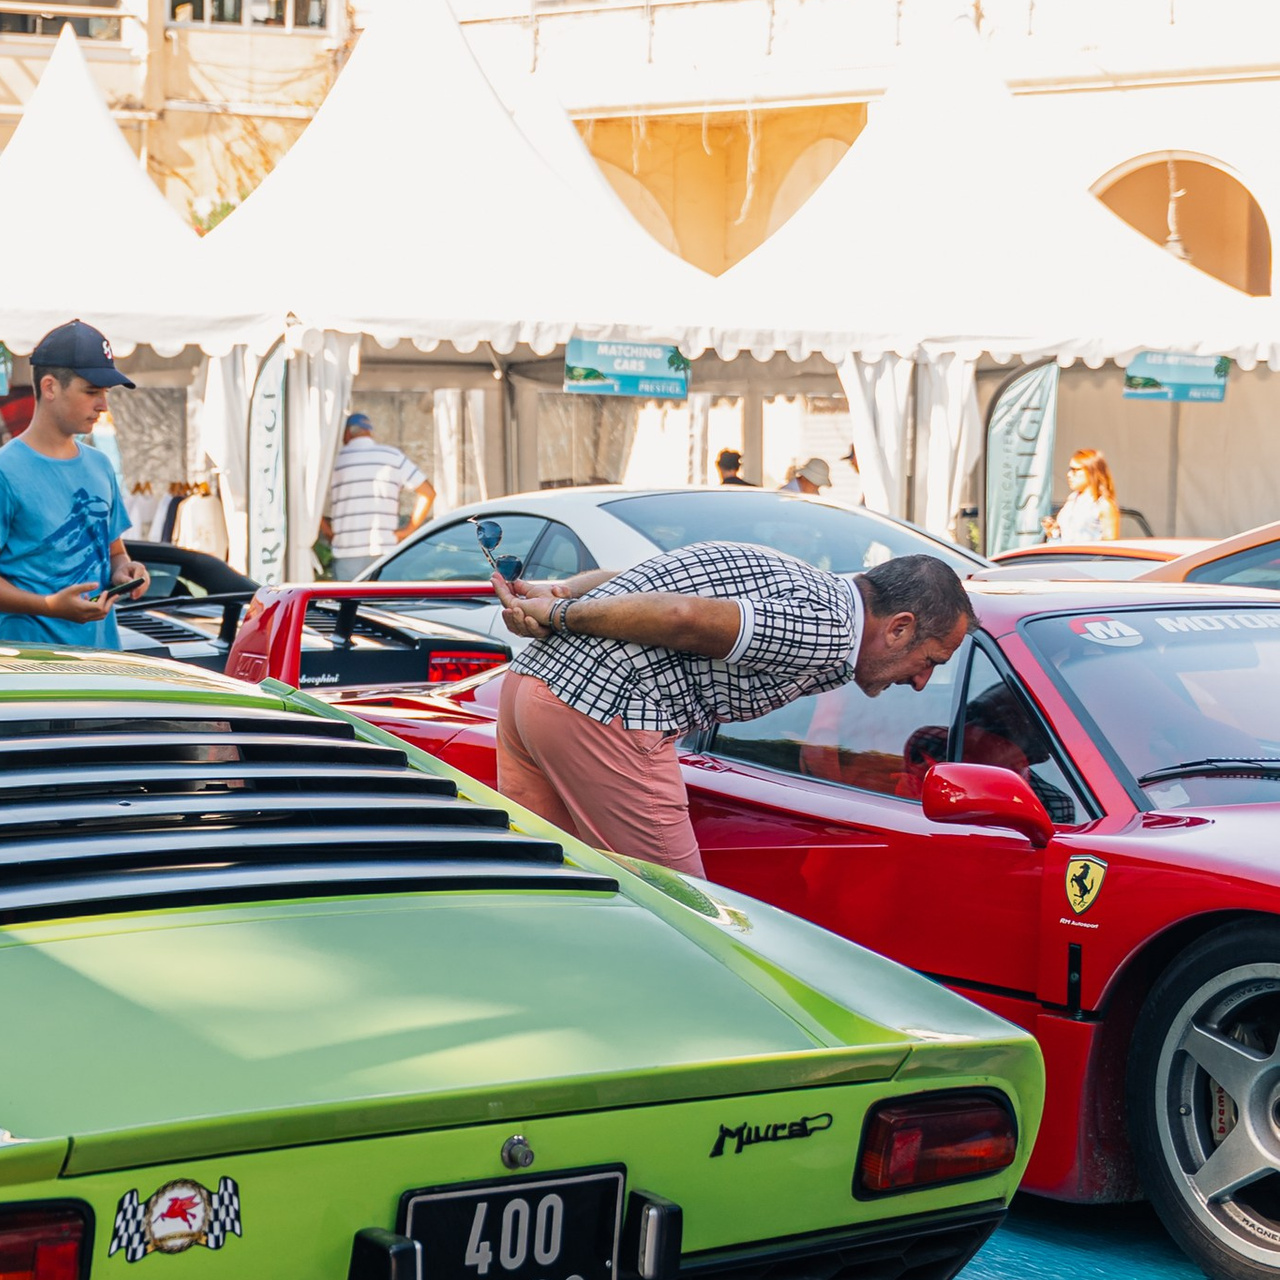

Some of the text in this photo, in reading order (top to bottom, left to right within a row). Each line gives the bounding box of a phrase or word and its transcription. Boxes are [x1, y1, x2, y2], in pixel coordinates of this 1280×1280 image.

[597, 344, 662, 359] MATCHING
[613, 359, 646, 372] CARS
[299, 673, 340, 686] borghini
[1071, 920, 1099, 929] Autosport
[1216, 1086, 1226, 1134] bremb
[464, 1193, 564, 1275] 400
[1242, 1217, 1280, 1242] MAGNE
